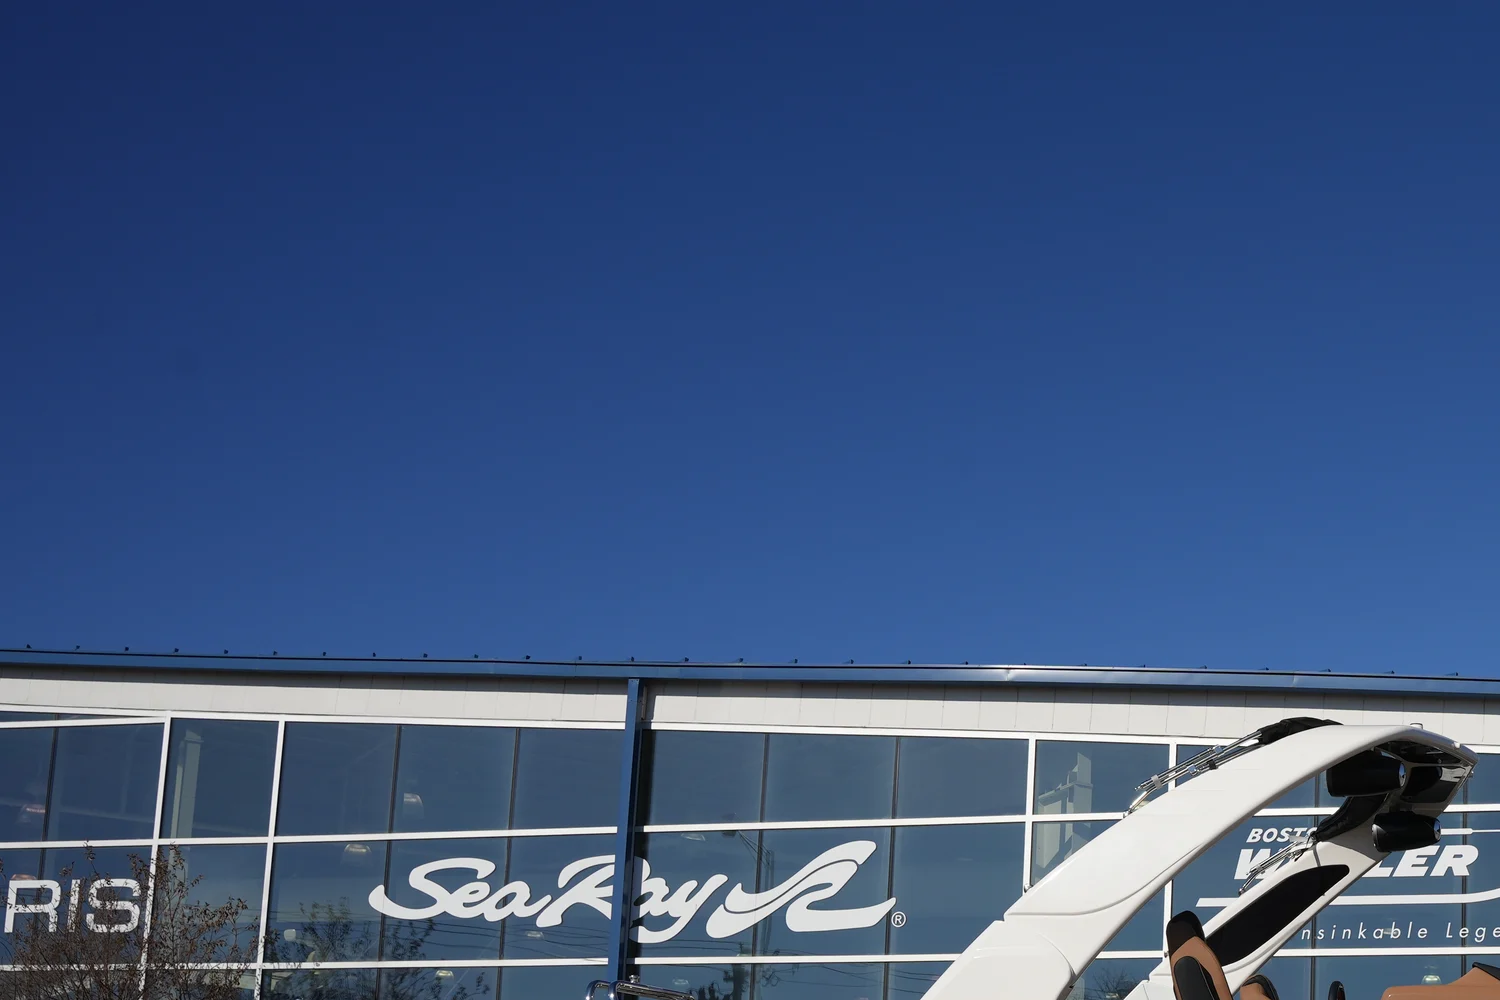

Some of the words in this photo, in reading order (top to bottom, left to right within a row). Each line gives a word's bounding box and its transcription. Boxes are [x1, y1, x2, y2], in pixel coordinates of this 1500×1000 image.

[1246, 827, 1318, 843] BOST
[1234, 844, 1479, 880] WLER
[368, 857, 552, 920] Sea
[1301, 921, 1428, 940] nsinkable
